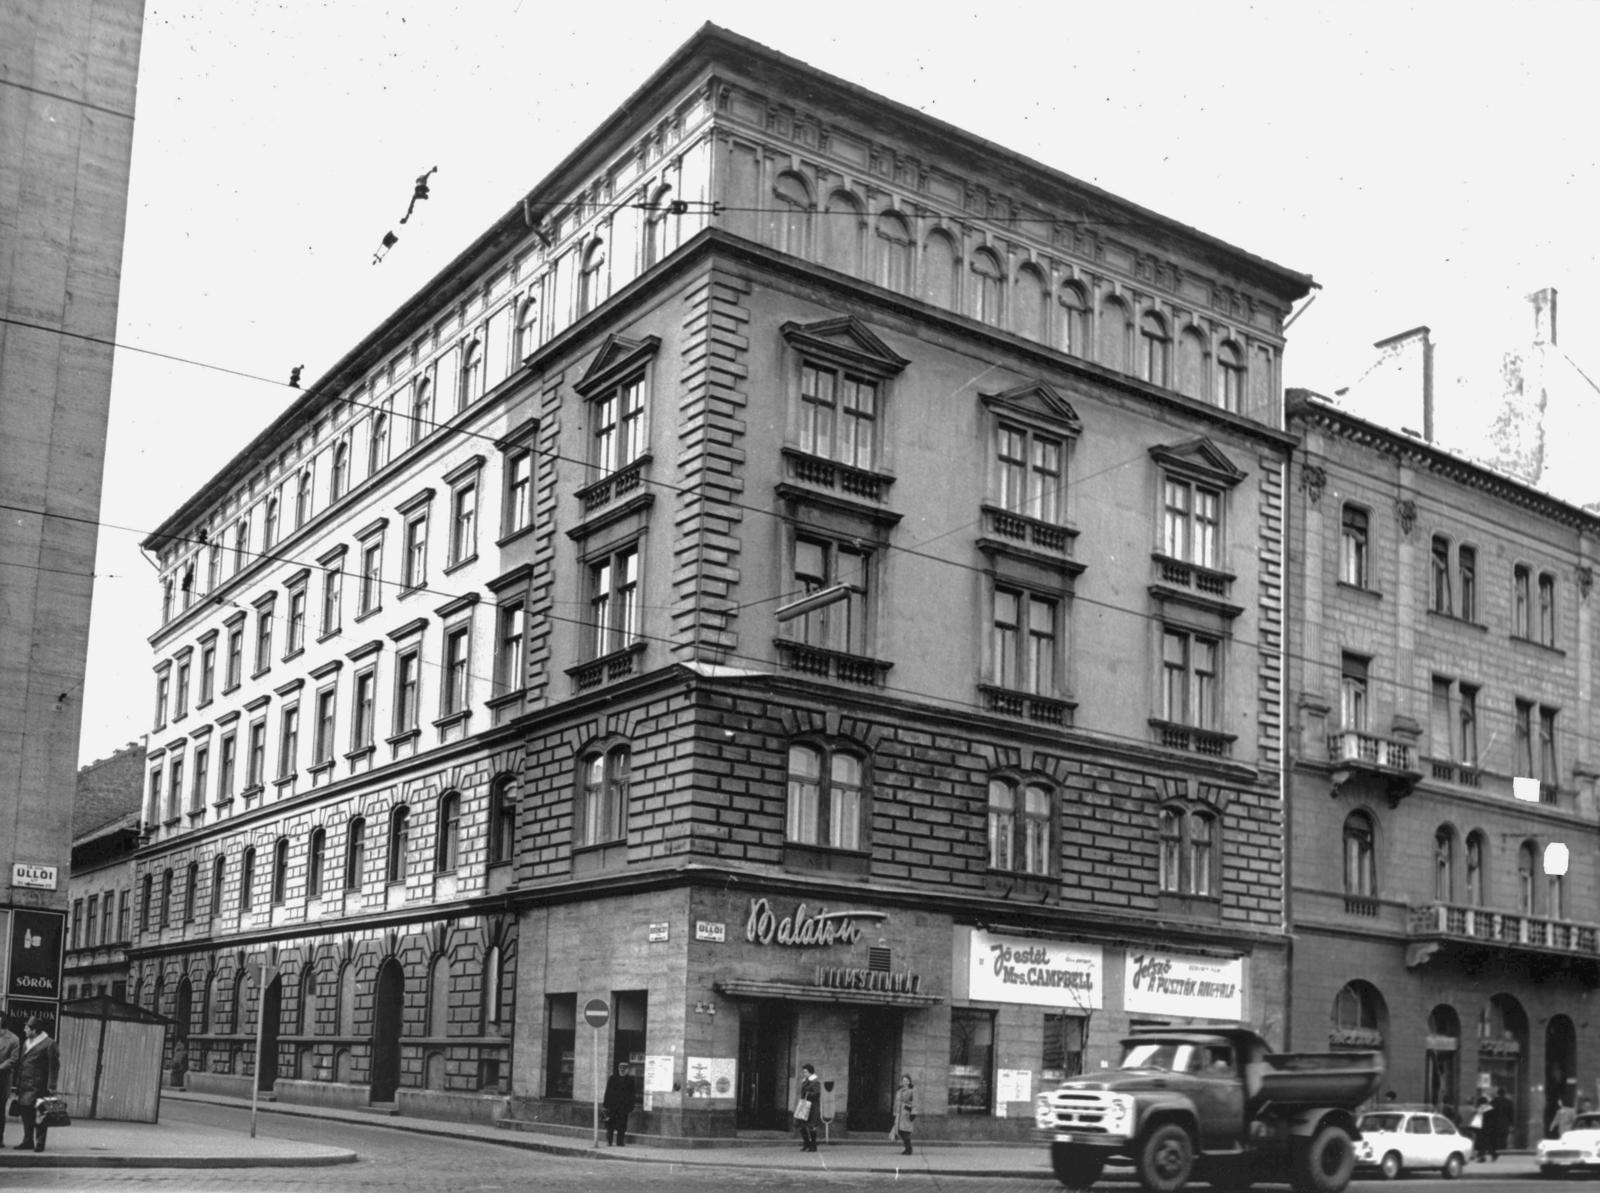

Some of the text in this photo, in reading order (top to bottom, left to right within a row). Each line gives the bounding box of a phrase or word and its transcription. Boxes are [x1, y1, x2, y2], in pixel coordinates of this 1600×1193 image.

[747, 898, 890, 945] Balaton
[16, 976, 53, 988] SÖRÖK
[1027, 967, 1093, 990] CAMPBELL
